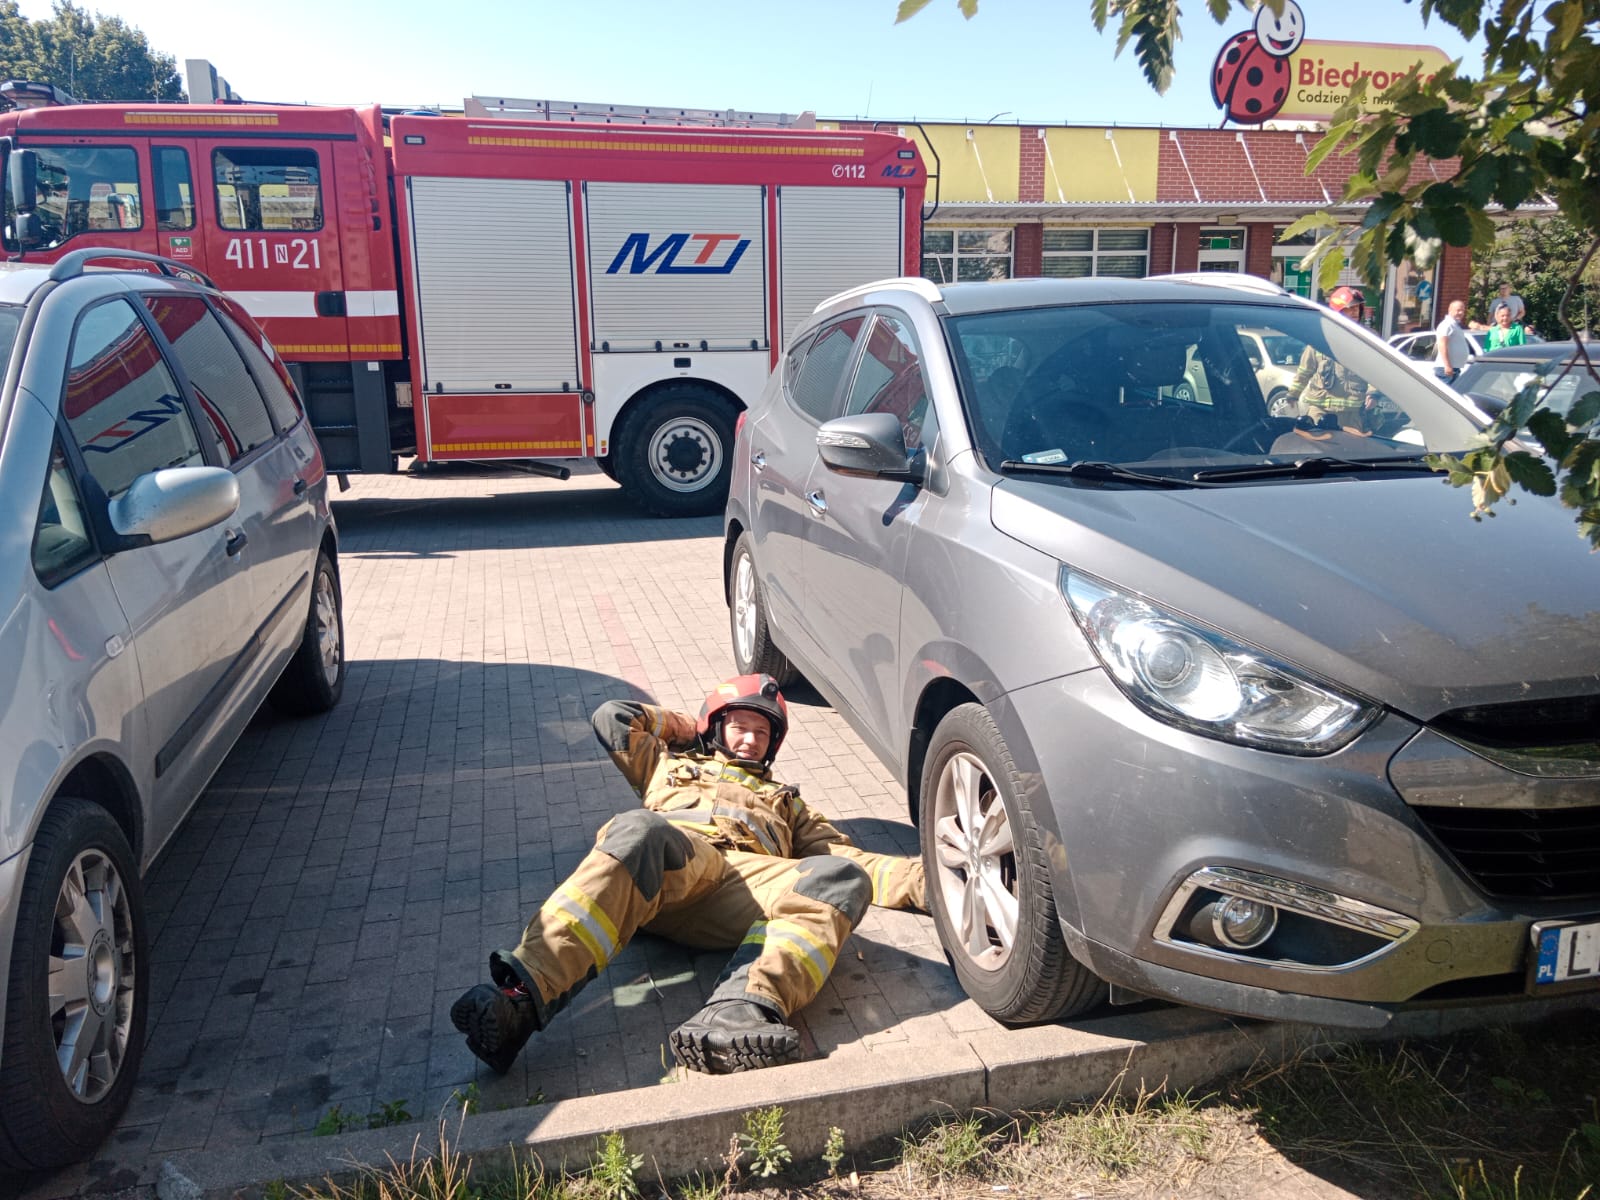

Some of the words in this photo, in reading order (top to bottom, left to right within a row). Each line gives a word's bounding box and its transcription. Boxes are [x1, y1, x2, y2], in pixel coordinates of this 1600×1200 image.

[844, 165, 865, 178] 112
[225, 238, 269, 269] 411
[275, 244, 288, 263] N
[291, 238, 321, 269] 21
[1567, 930, 1600, 977] L
[1538, 965, 1553, 978] PL
